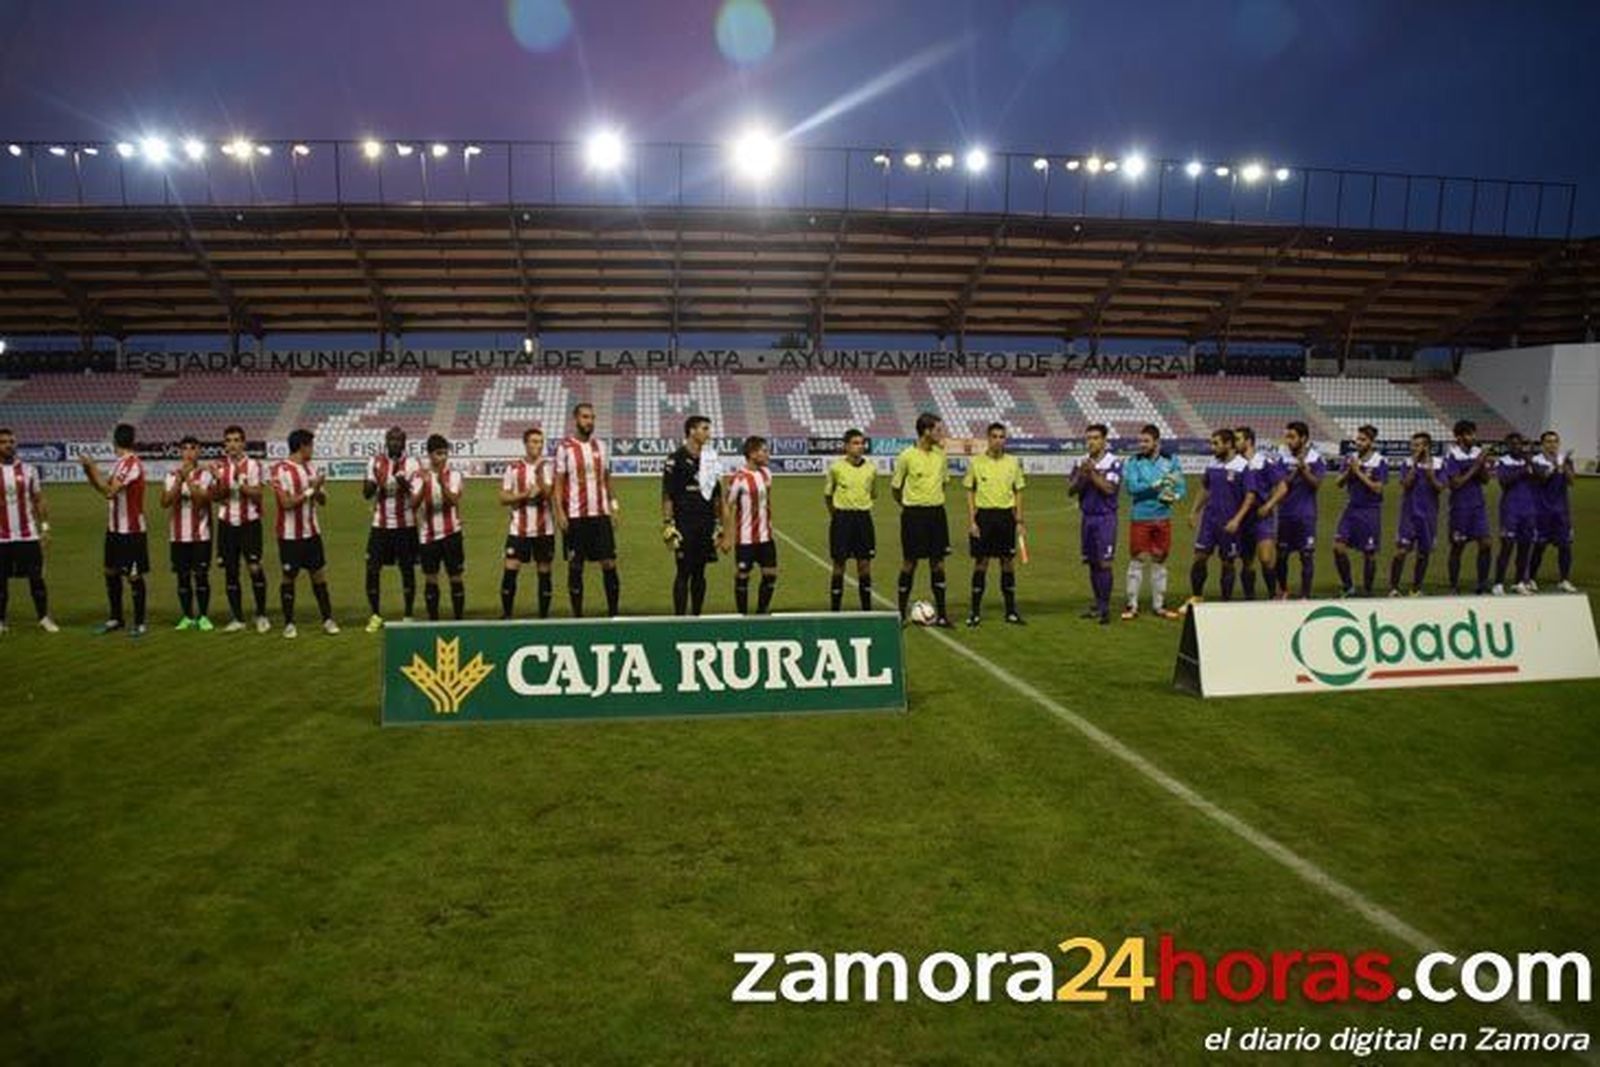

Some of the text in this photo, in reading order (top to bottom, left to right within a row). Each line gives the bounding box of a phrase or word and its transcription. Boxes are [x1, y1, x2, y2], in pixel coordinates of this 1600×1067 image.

[271, 350, 439, 369] MUNICIPAL
[452, 350, 534, 368] RUTA
[544, 350, 583, 368] DE
[595, 350, 637, 368] LA
[647, 350, 743, 368] PLATA
[778, 351, 1007, 369] AYUNTAMIENTO
[1015, 354, 1052, 371] DE
[1062, 354, 1188, 373] ZAMORA
[315, 376, 1178, 440] ZAMORA
[506, 638, 893, 697] CAJA RURAL
[1291, 605, 1514, 686] Cobadu
